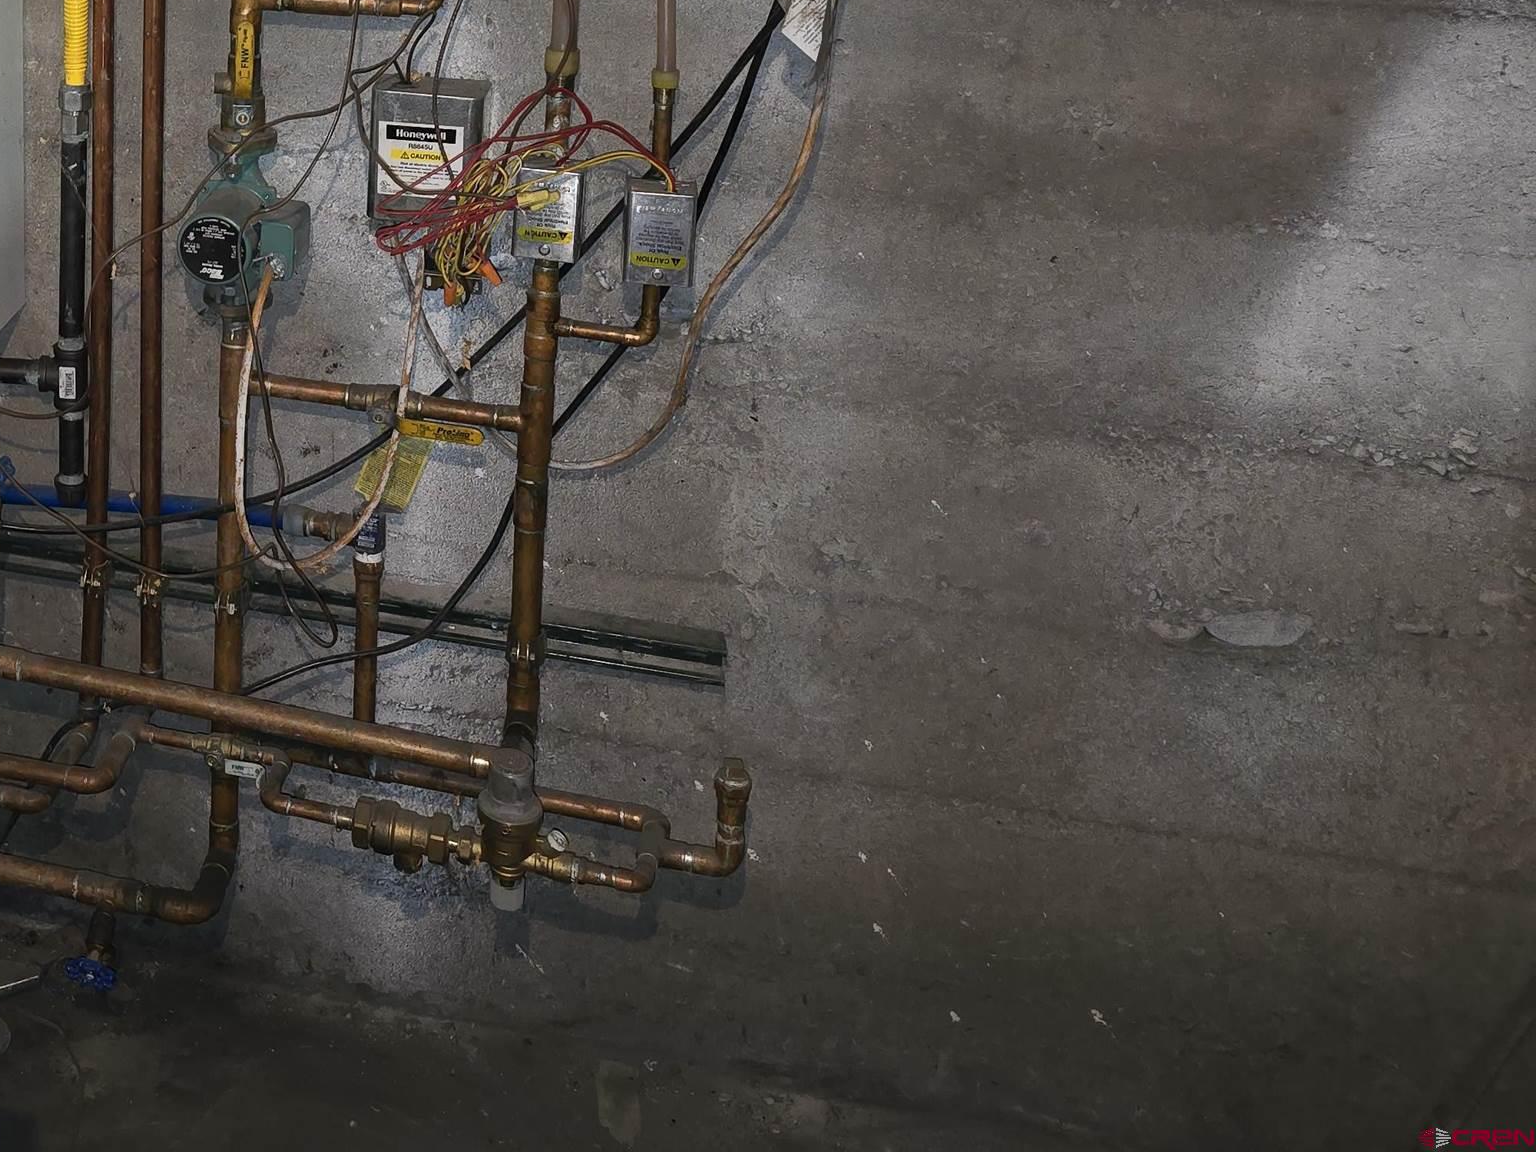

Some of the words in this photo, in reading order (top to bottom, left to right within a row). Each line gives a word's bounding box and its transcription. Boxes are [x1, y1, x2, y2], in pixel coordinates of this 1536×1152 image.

[240, 47, 250, 69] FNW
[396, 128, 447, 141] Honeywll
[410, 152, 441, 161] CAUTION
[524, 230, 558, 239] CAUTION
[636, 255, 670, 265] CAUTION
